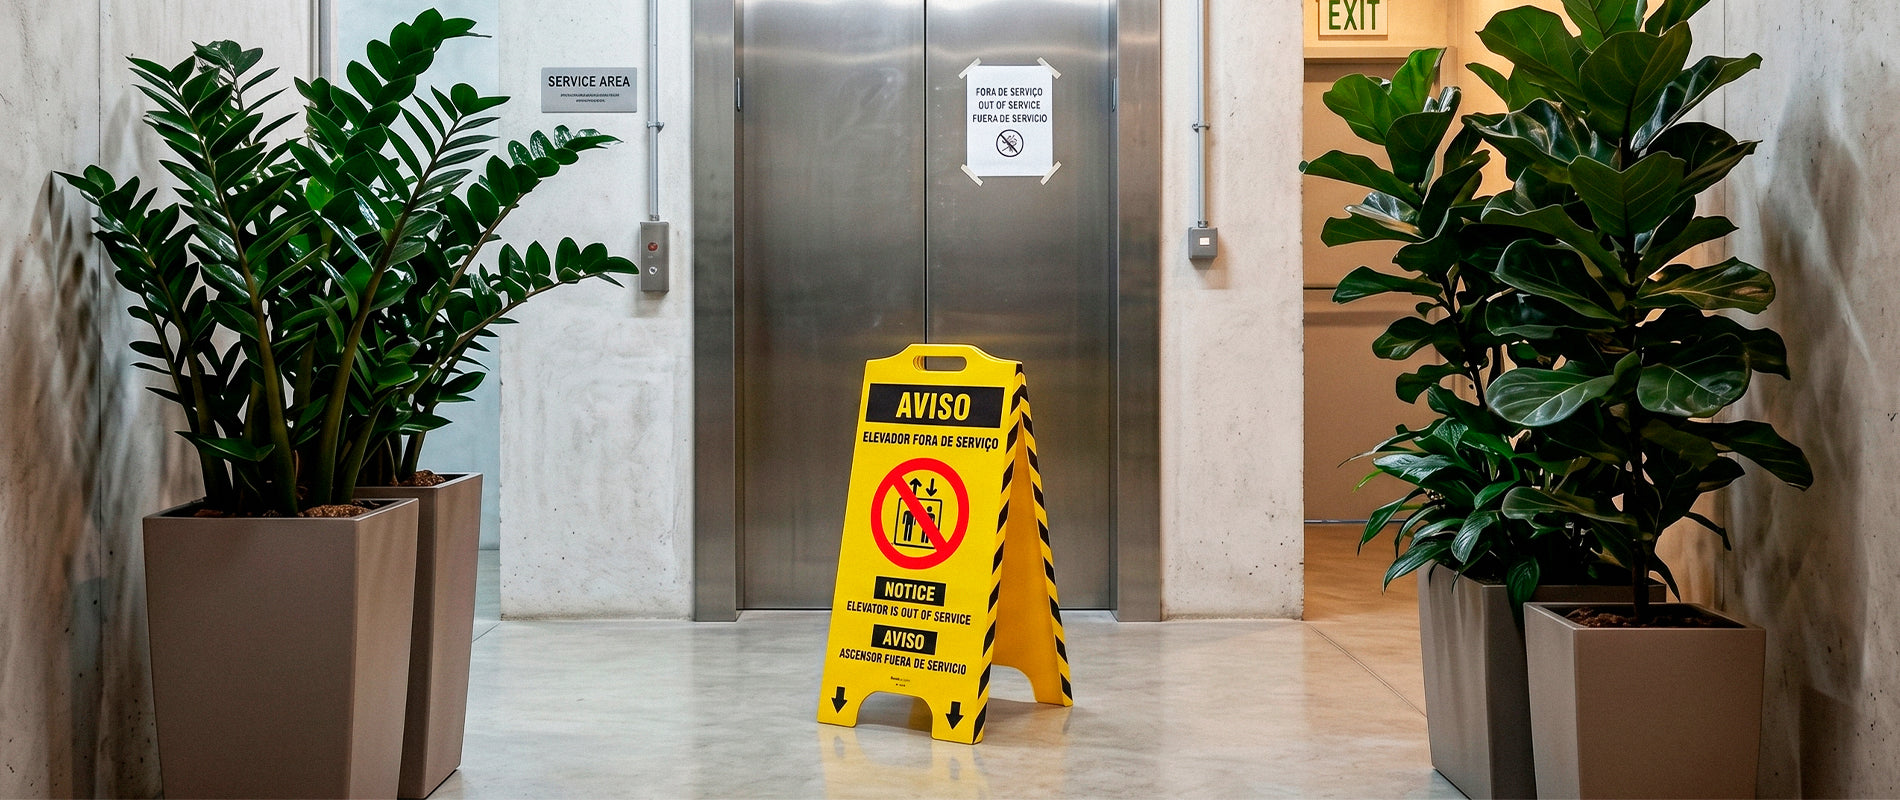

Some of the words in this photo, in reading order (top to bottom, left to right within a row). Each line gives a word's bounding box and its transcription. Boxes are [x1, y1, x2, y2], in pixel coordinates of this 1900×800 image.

[1329, 0, 1380, 30] EXIT
[548, 75, 596, 87] SERVICE
[599, 75, 630, 87] AREA
[976, 87, 996, 96] FORA
[998, 87, 1008, 96] DE
[1010, 87, 1043, 98] SERVIÇO
[978, 101, 994, 109] OUT
[996, 101, 1006, 109] OF
[1008, 101, 1041, 109] SERVICE
[972, 114, 998, 123] FUERA
[1000, 114, 1010, 123] DE
[1012, 114, 1048, 123] SERVICIO
[895, 391, 971, 421] AVISO
[863, 431, 910, 445] ELEVADOR
[912, 433, 938, 447] FORA
[940, 435, 954, 447] DE
[956, 436, 999, 452] SERVIÇO
[884, 581, 936, 602] NOTICE
[846, 600, 889, 615] ELEVATOR
[890, 606, 899, 616] IS
[901, 607, 919, 619] OUT
[921, 609, 932, 621] OF
[934, 611, 971, 626] SERVICE
[882, 629, 925, 650] AVISO
[839, 648, 882, 664] ASCENSOR
[884, 654, 911, 668] FUERA
[913, 658, 925, 670] DE
[927, 659, 967, 675] SERVICIO
